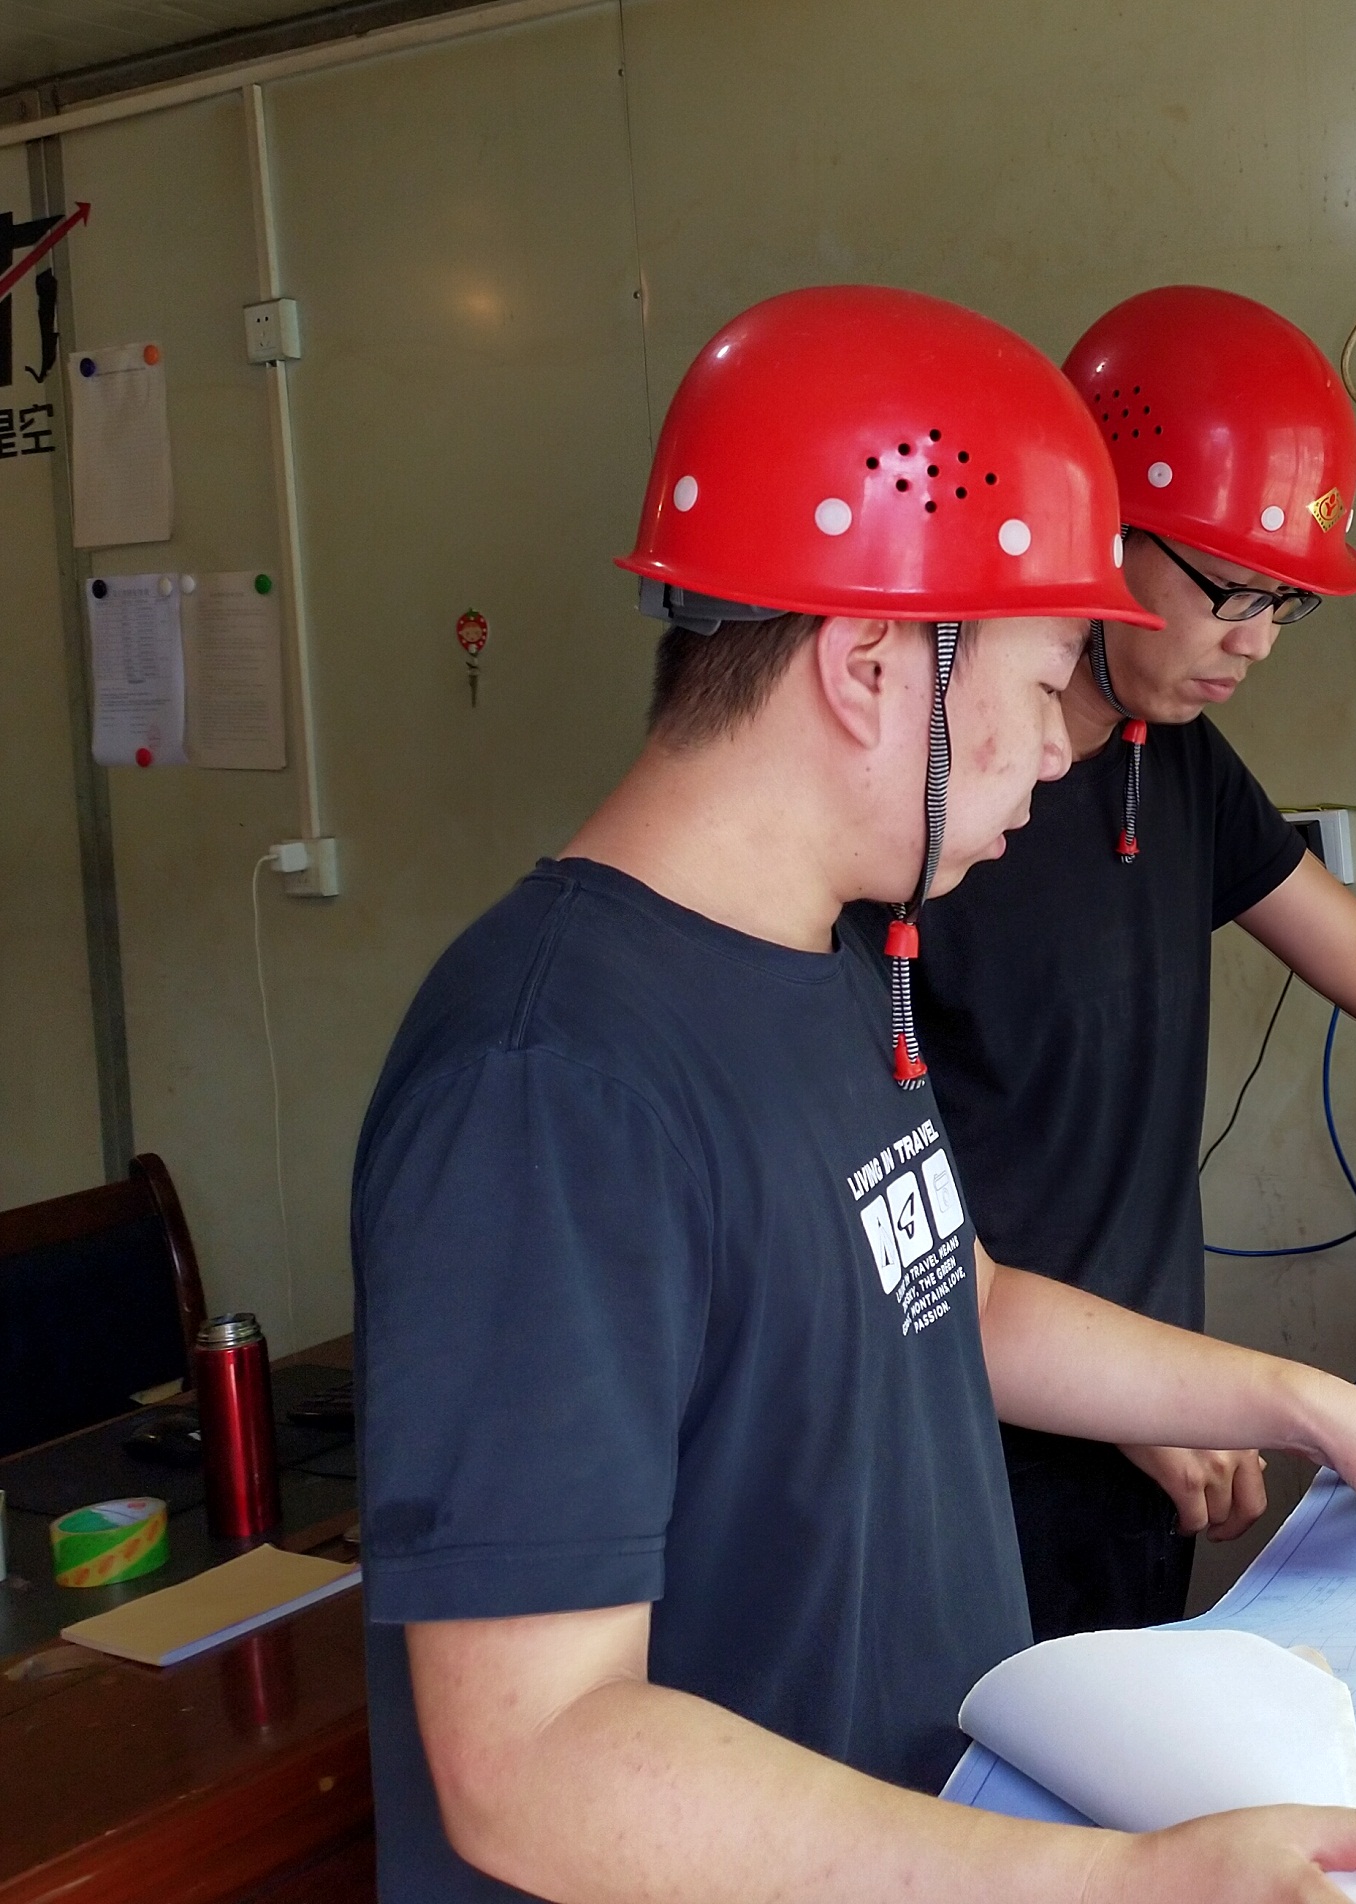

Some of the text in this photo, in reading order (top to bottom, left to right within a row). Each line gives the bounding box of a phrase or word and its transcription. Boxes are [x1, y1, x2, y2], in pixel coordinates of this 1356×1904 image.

[847, 1118, 940, 1201] LIVING IN TRAVEL
[909, 1253, 940, 1280] TRAVEL
[918, 1272, 937, 1292] THE
